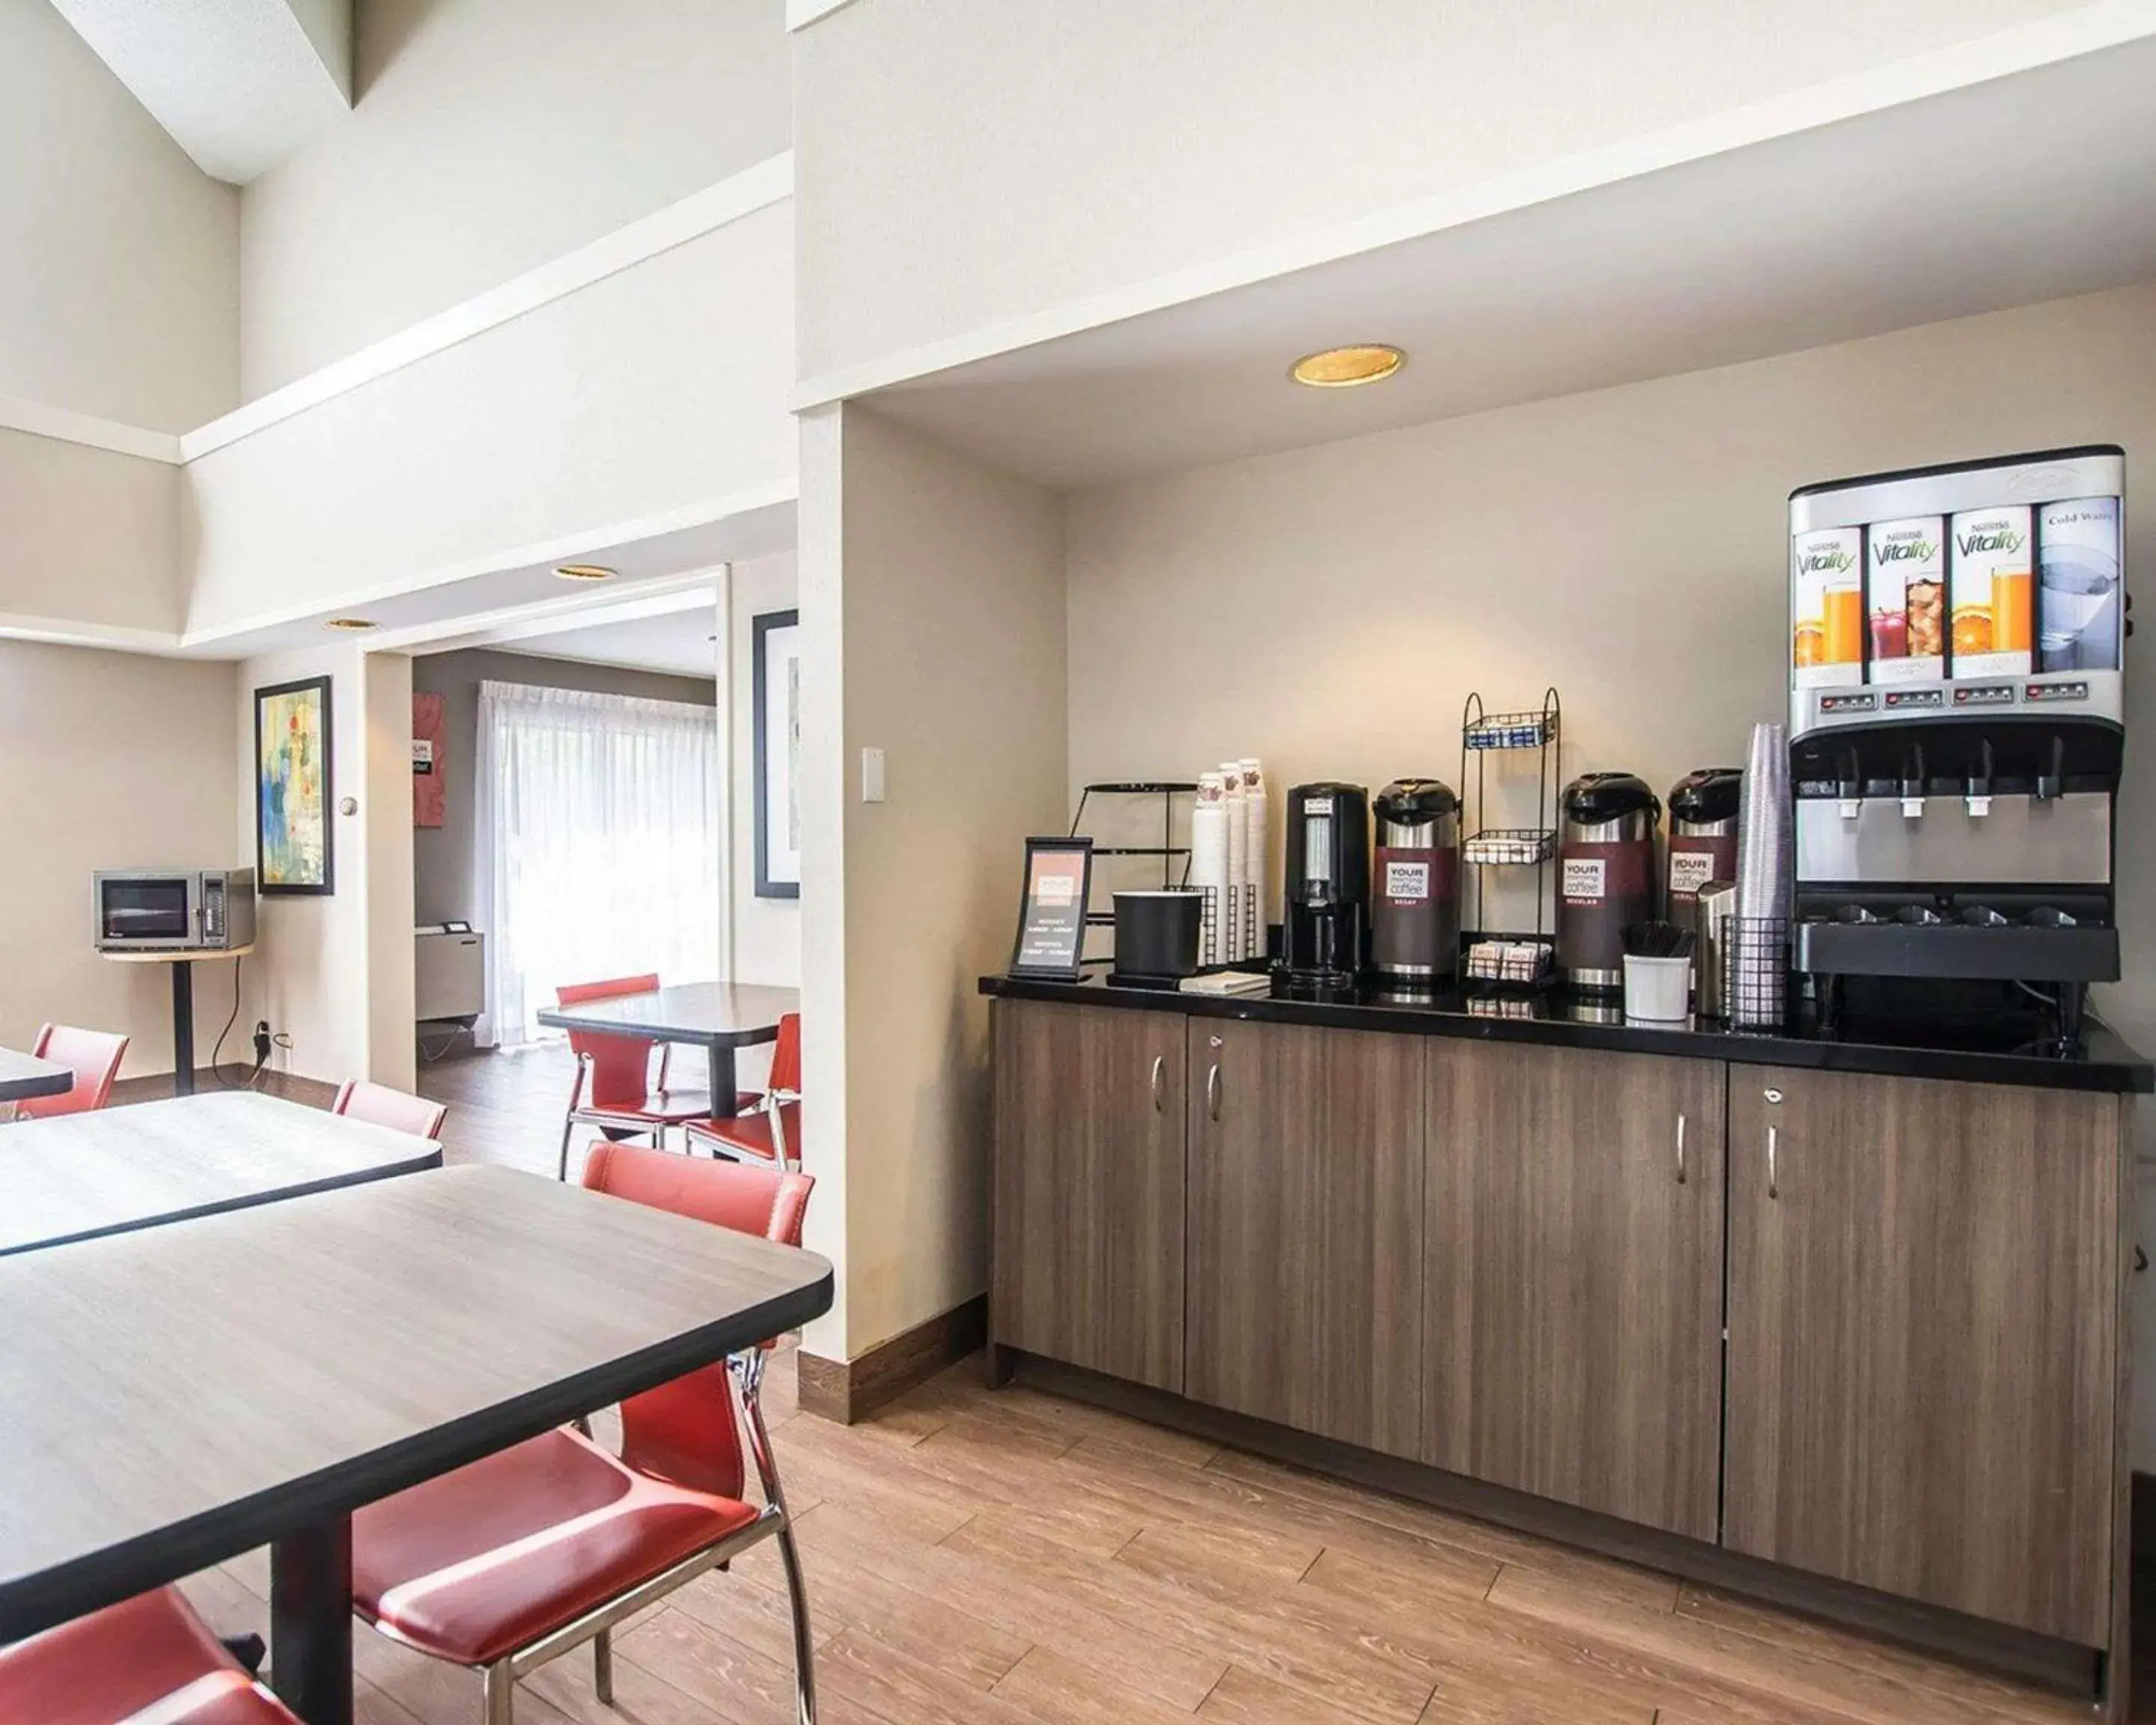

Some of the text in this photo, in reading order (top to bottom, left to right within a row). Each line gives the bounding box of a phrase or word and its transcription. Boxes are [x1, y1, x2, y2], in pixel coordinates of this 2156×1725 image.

[2049, 514, 2077, 525] Cold
[1956, 531, 2026, 558] Vitality
[1873, 541, 1937, 567] Vitality
[1797, 552, 1856, 576] Vitality
[1567, 865, 1599, 874] YOUR
[1675, 859, 1707, 868] YOUR
[1391, 868, 1424, 877] YOUR
[1390, 883, 1423, 895] coffee
[1566, 881, 1598, 893] coffee
